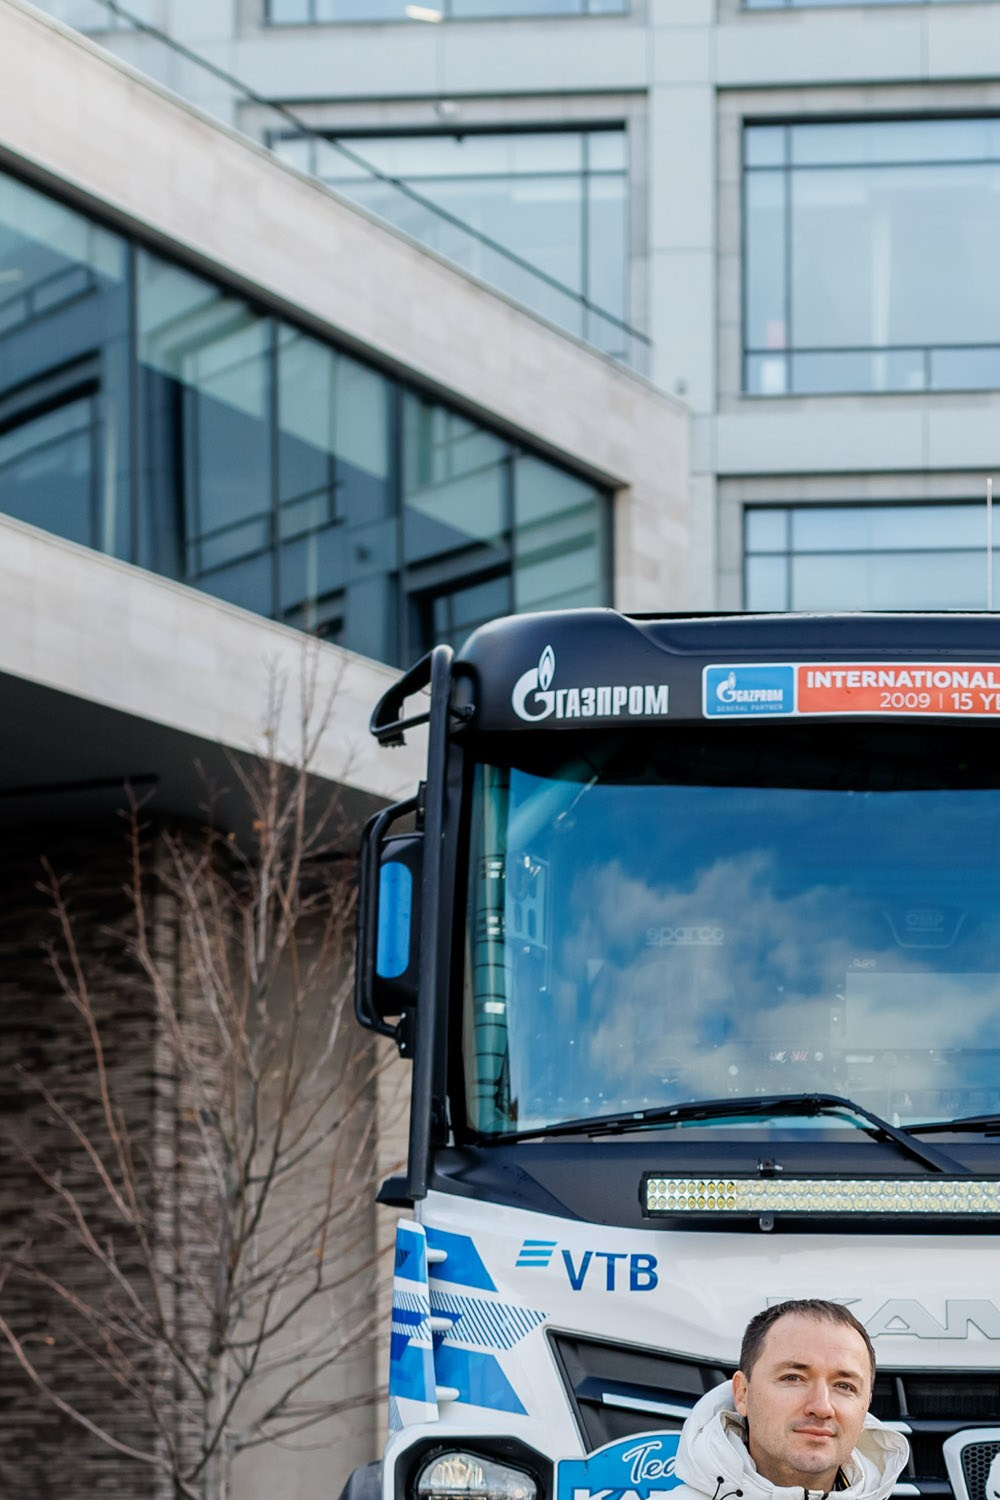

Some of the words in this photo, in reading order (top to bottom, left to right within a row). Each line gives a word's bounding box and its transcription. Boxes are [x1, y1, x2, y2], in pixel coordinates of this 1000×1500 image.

[807, 670, 1000, 690] INTERNATIONAL
[879, 692, 931, 709] 2009
[951, 693, 972, 710] 15
[645, 926, 725, 947] sparco
[560, 1249, 659, 1292] VTB
